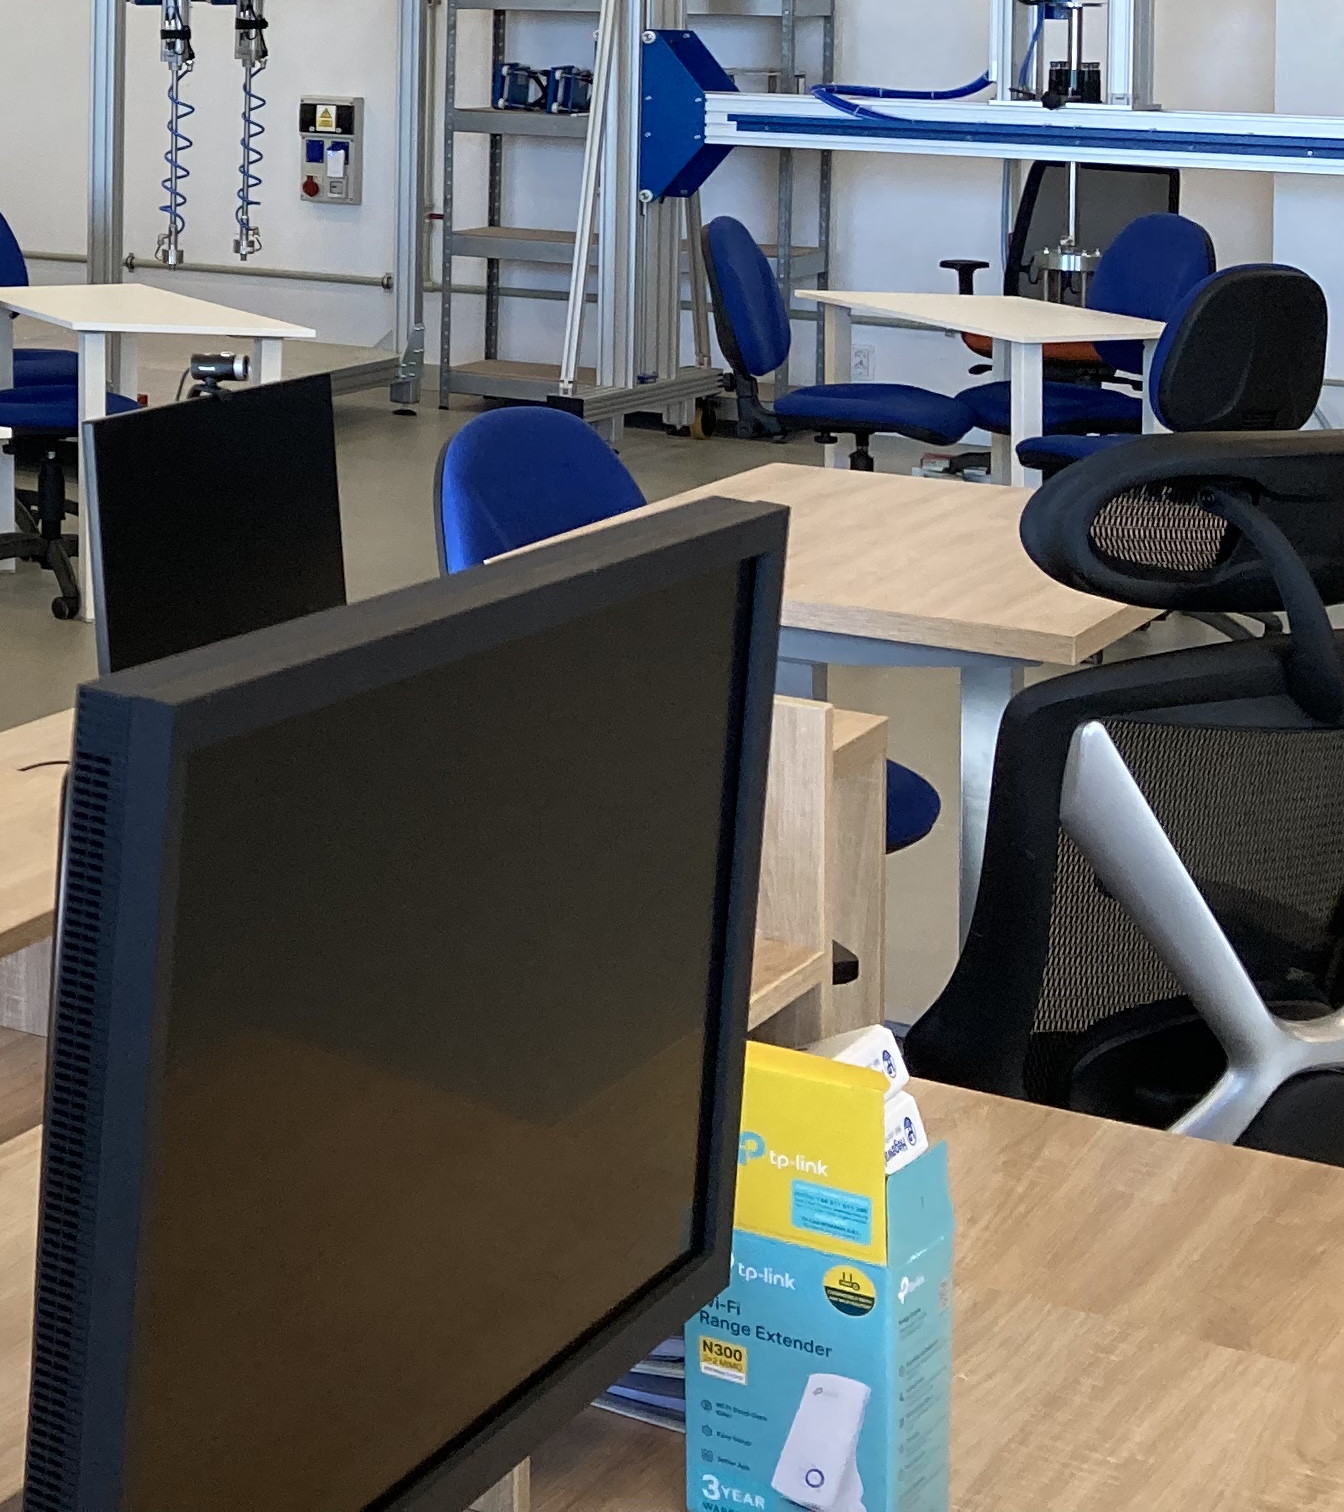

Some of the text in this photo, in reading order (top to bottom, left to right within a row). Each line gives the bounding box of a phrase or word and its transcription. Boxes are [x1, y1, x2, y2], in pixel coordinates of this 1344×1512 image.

[769, 1150, 829, 1176] tp-link
[738, 1262, 796, 1290] tp-link
[699, 1310, 833, 1358] Range Extender
[702, 1339, 743, 1362] N300
[701, 1473, 721, 1501] 3
[720, 1485, 765, 1510] YEAR
